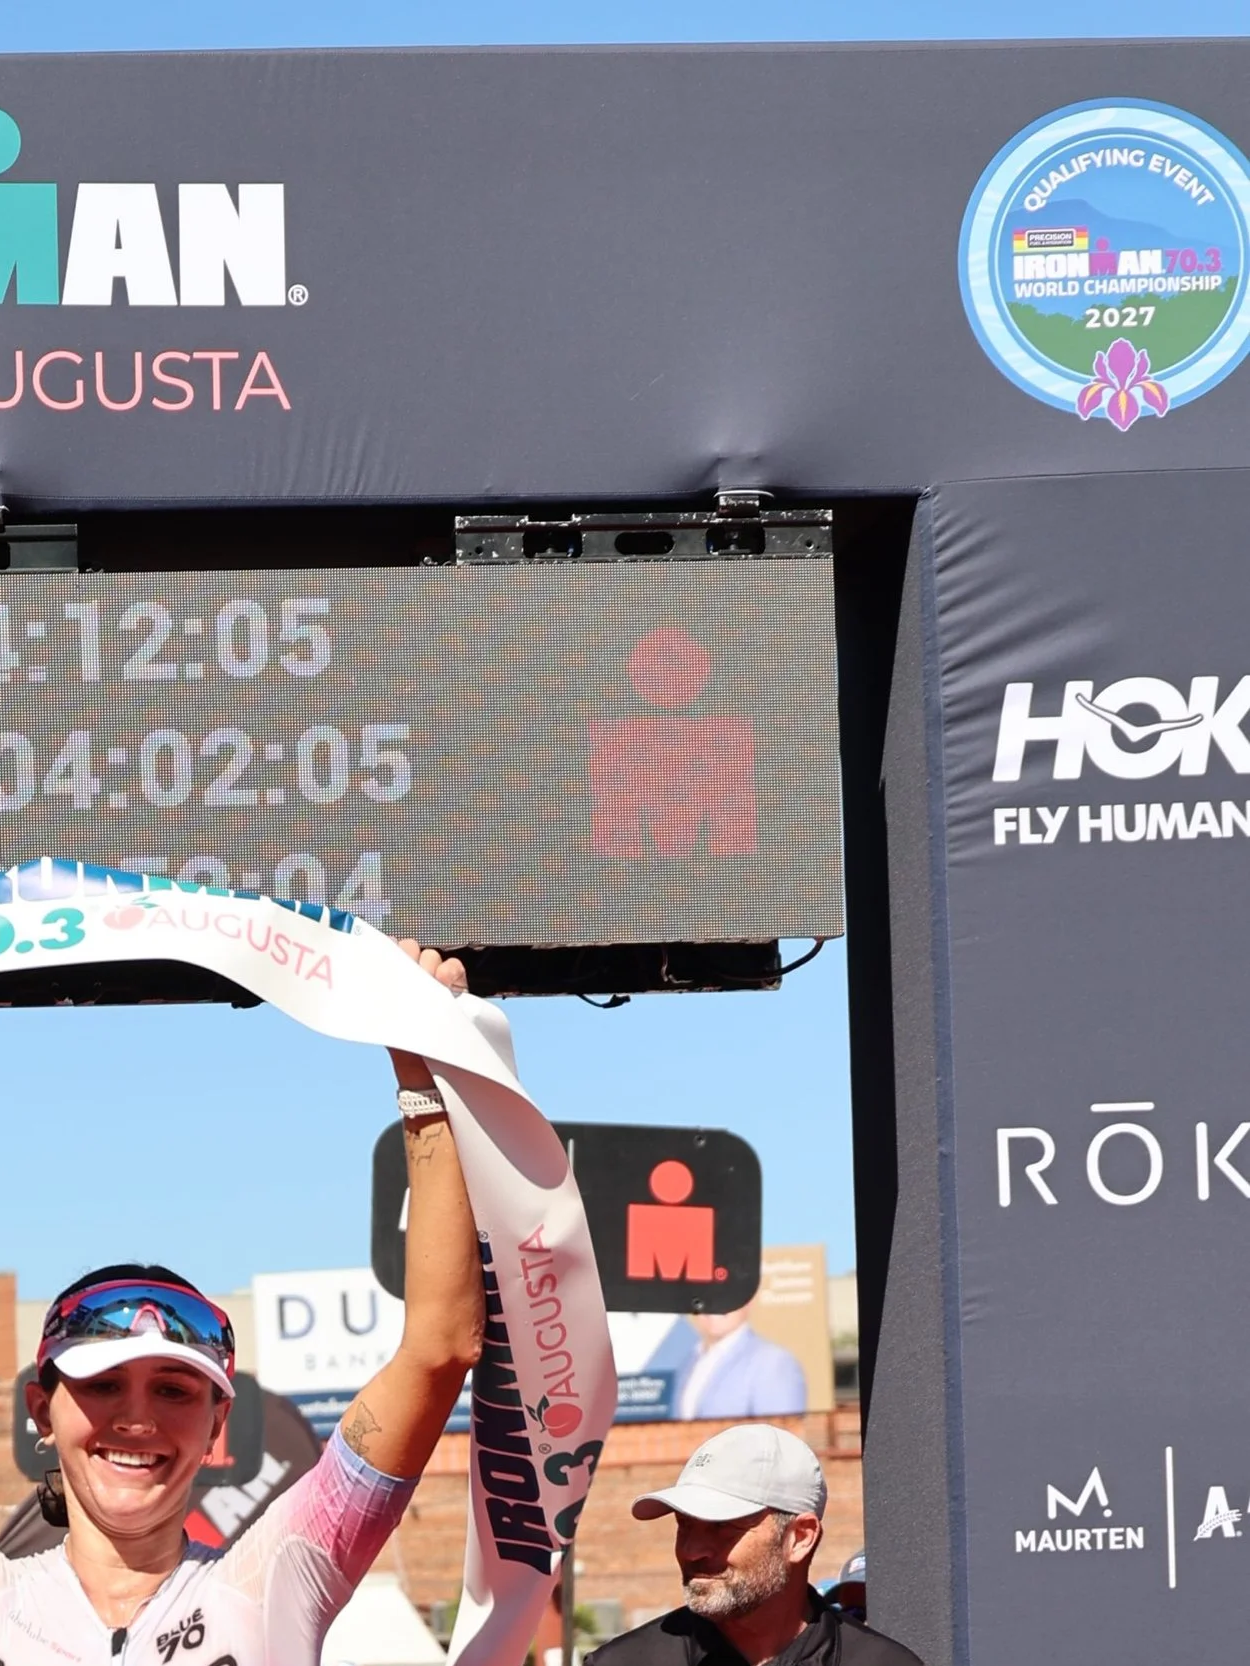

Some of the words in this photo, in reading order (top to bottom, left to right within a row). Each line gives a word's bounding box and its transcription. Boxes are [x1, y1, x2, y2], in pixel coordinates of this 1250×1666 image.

[1024, 148, 1144, 212] QUALIFYING
[1148, 155, 1215, 207] EVENT
[1013, 237, 1162, 280] IRONMAN
[1166, 248, 1222, 274] 70.3
[1014, 280, 1080, 299] WORLD
[1083, 275, 1223, 296] CHAMPIONSHIP
[1085, 306, 1155, 328] 2027
[992, 674, 1250, 782] HOK
[994, 805, 1069, 845] FLY
[1078, 800, 1250, 843] HUMAN
[145, 905, 335, 990] AUGUSTA
[517, 1224, 584, 1399] AUGUSTA
[1015, 1527, 1145, 1553] MAURTEN
[156, 1608, 204, 1648] BLUE
[158, 1623, 205, 1665] 70
